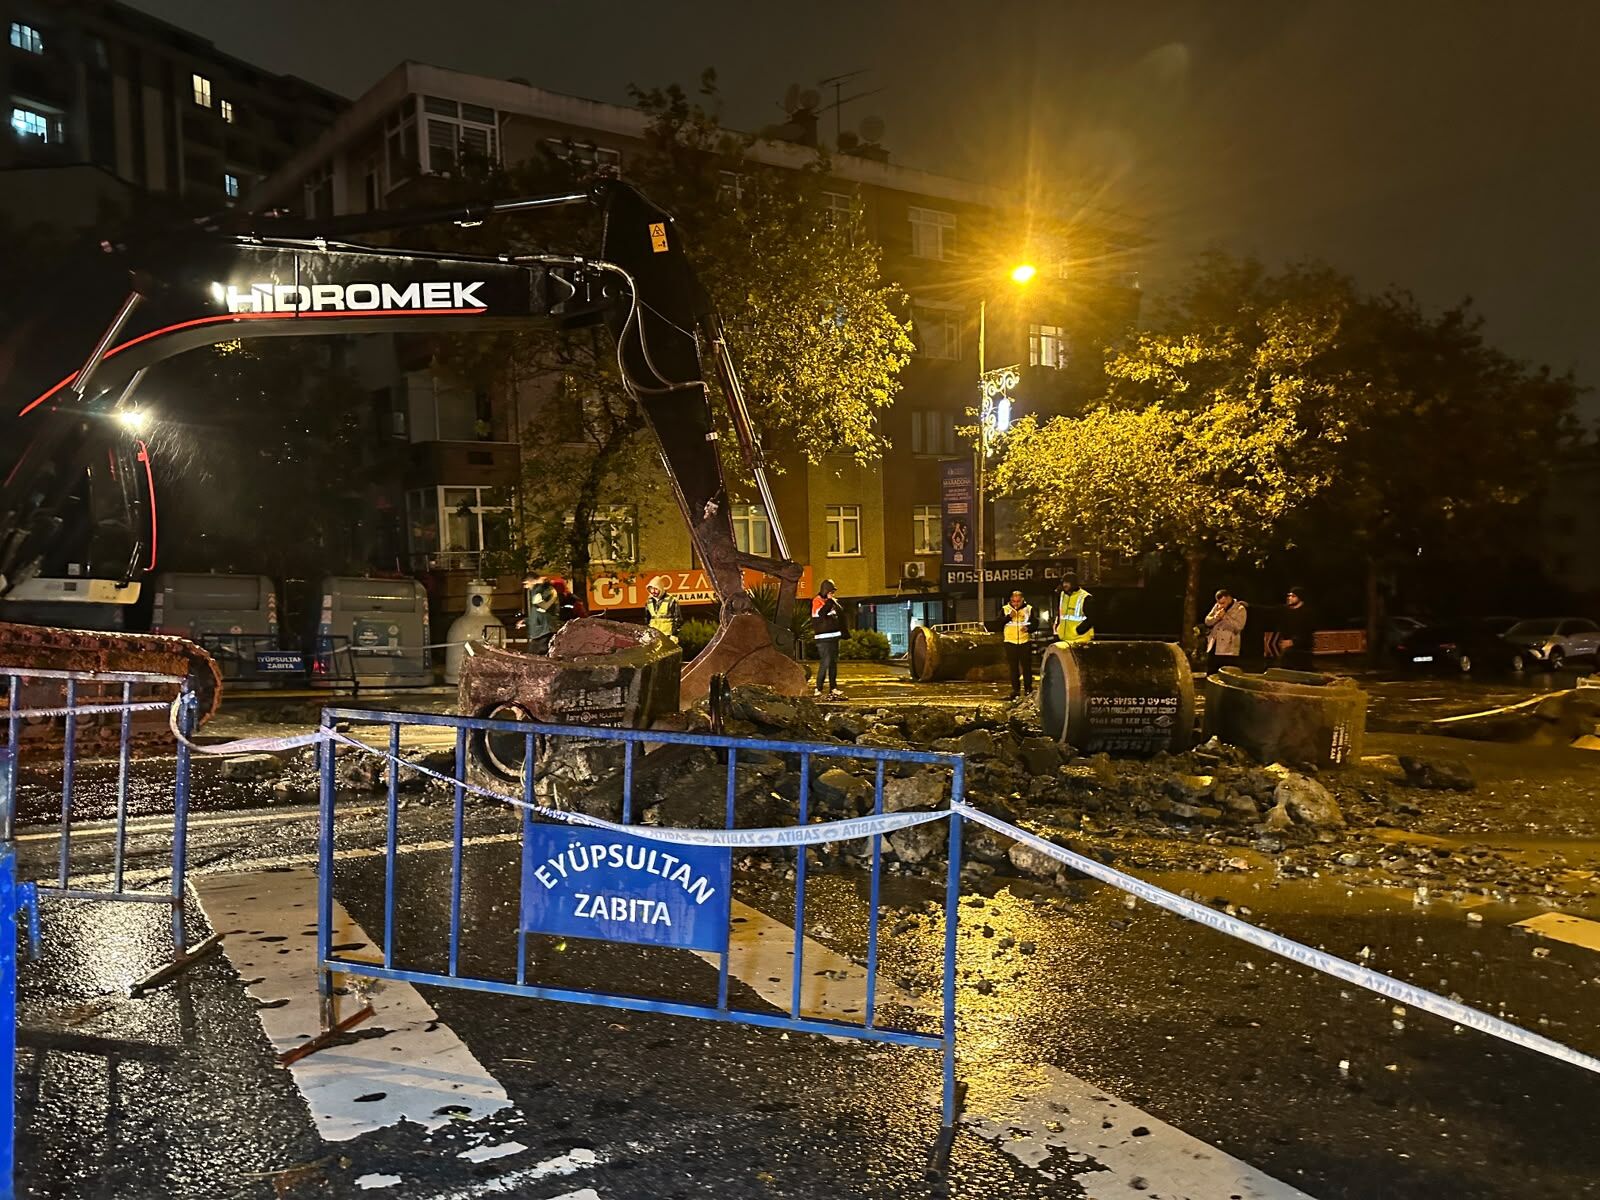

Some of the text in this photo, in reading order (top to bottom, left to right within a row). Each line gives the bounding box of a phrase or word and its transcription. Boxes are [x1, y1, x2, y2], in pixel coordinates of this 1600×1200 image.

[985, 568, 1033, 581] BARBER
[534, 842, 716, 905] EYÜPSULTAN
[574, 893, 672, 927] ZABITA
